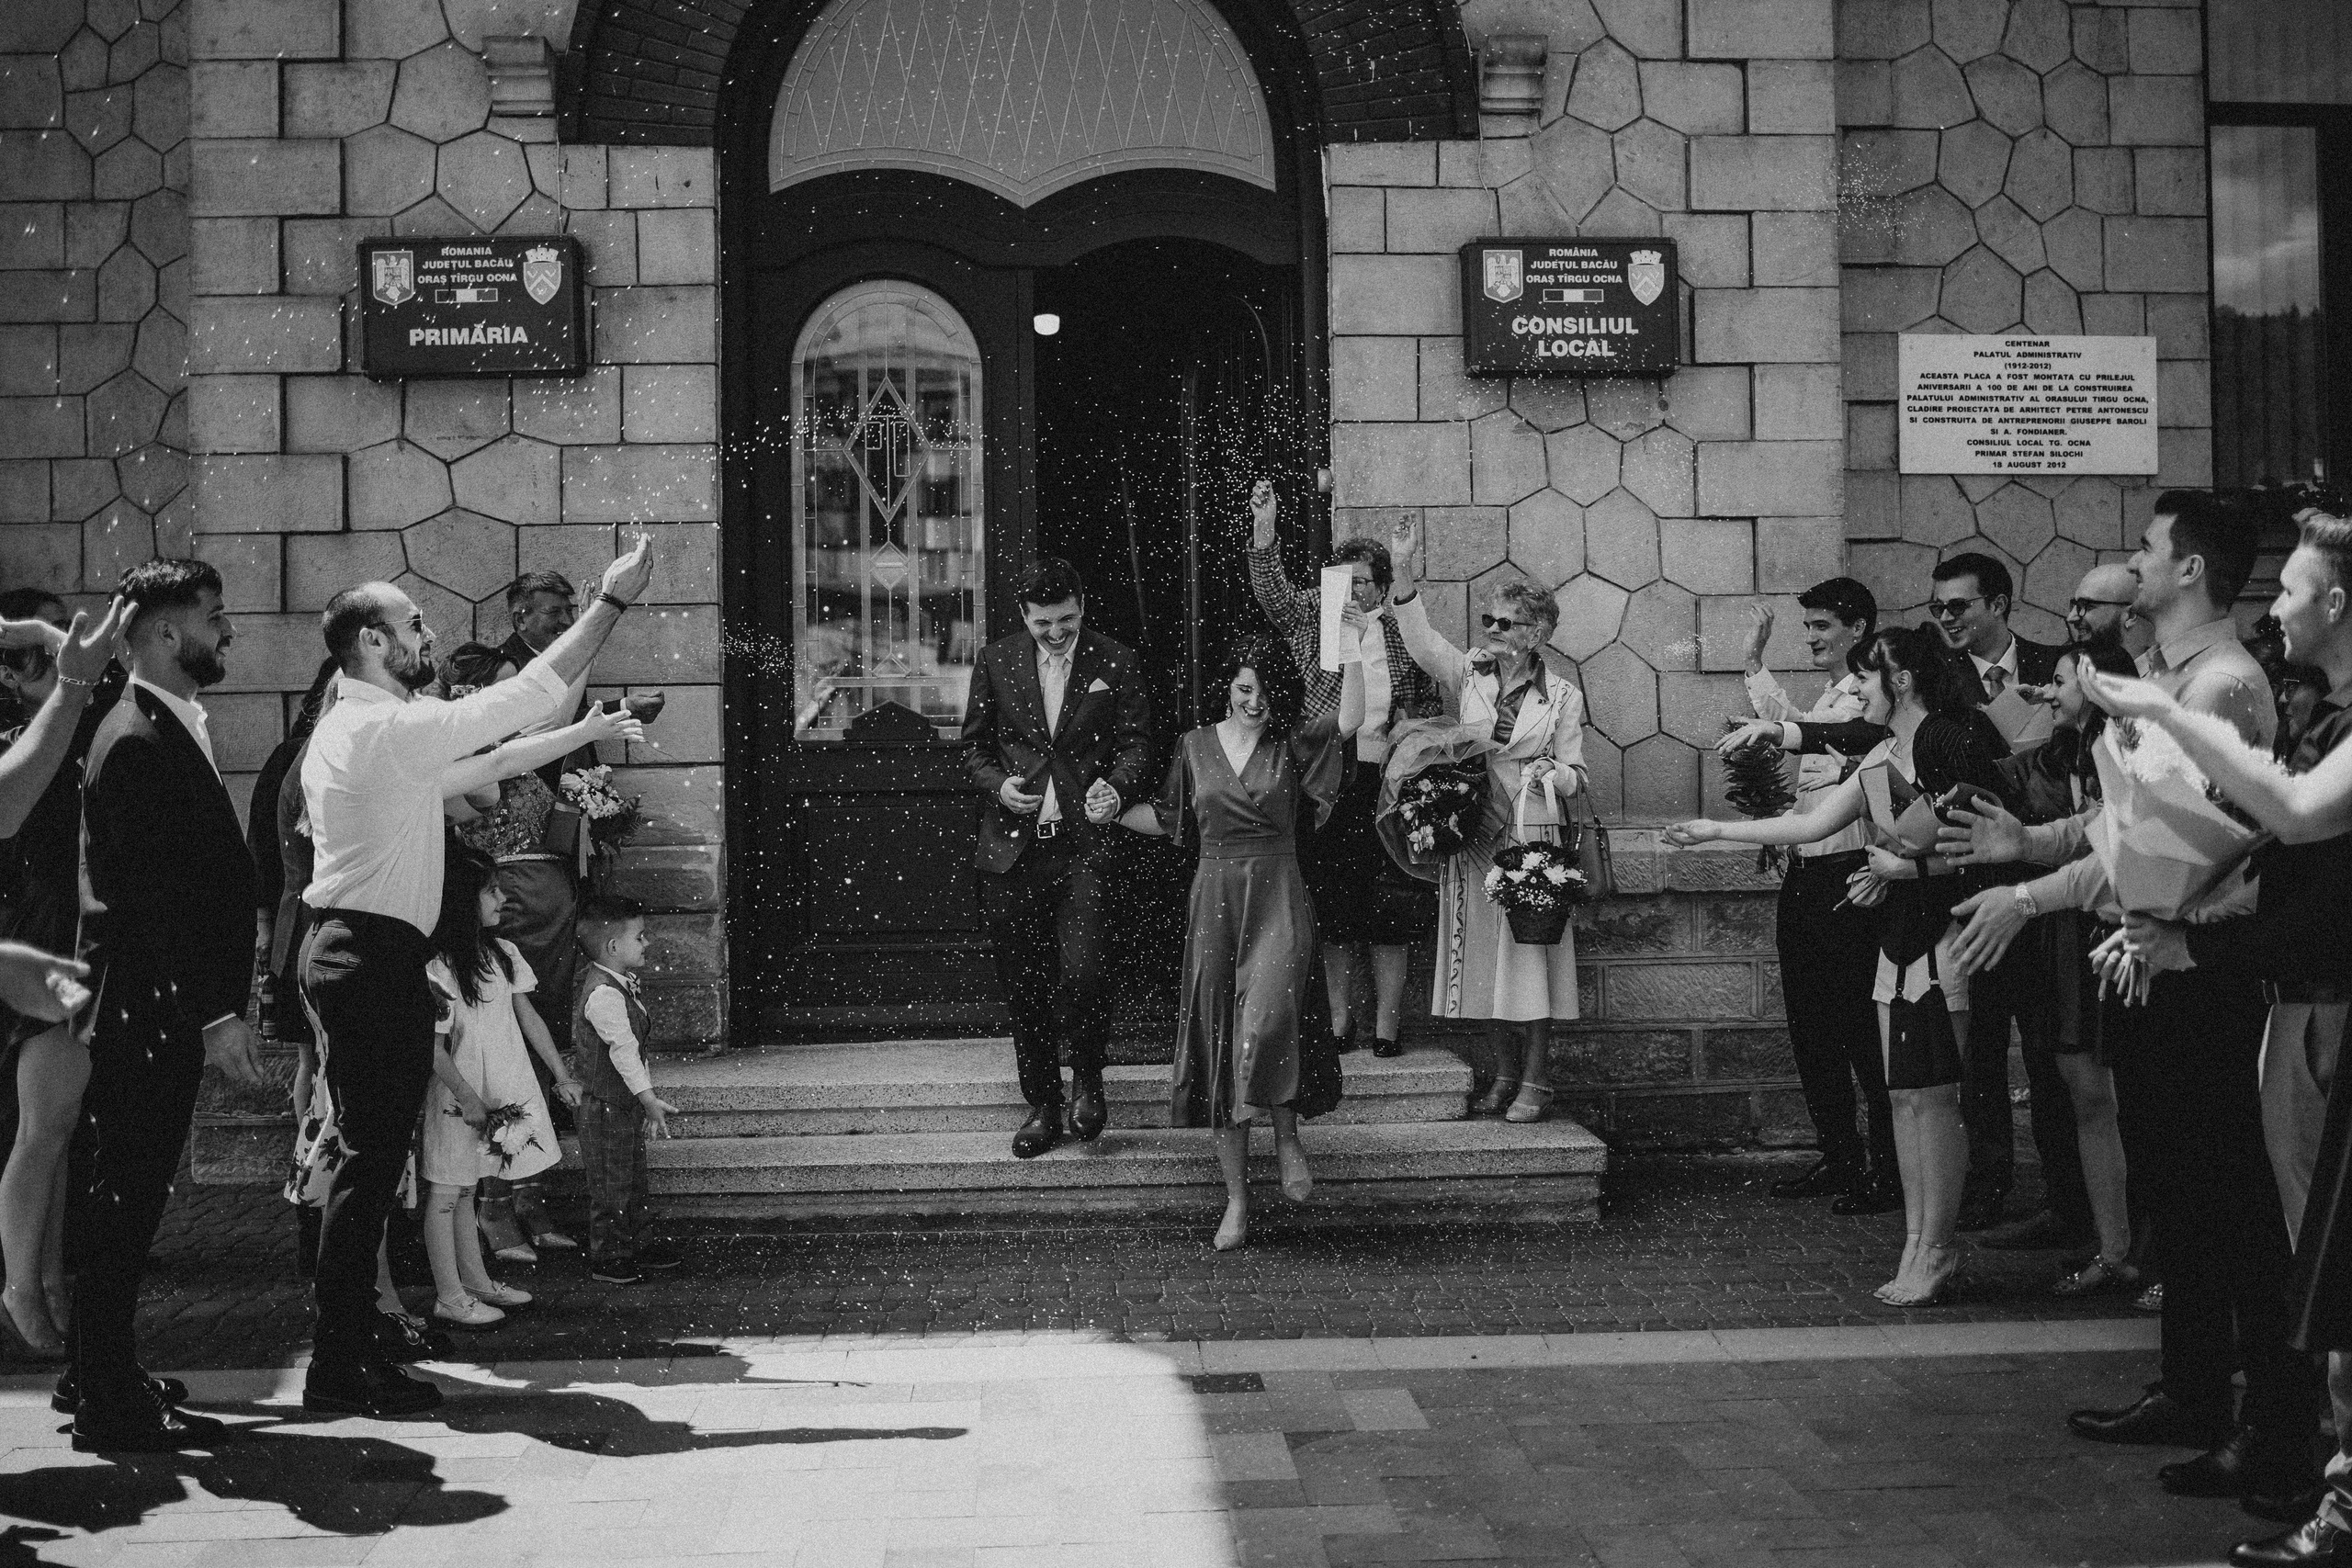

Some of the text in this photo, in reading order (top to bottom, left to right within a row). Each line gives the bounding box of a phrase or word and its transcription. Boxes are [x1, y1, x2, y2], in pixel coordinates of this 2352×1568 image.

[441, 246, 492, 256] ROMANIA
[486, 274, 517, 282] OCNA
[1592, 275, 1623, 283] OCNA
[1511, 317, 1639, 334] CONSILIUL
[1538, 340, 1615, 356] LOCAL
